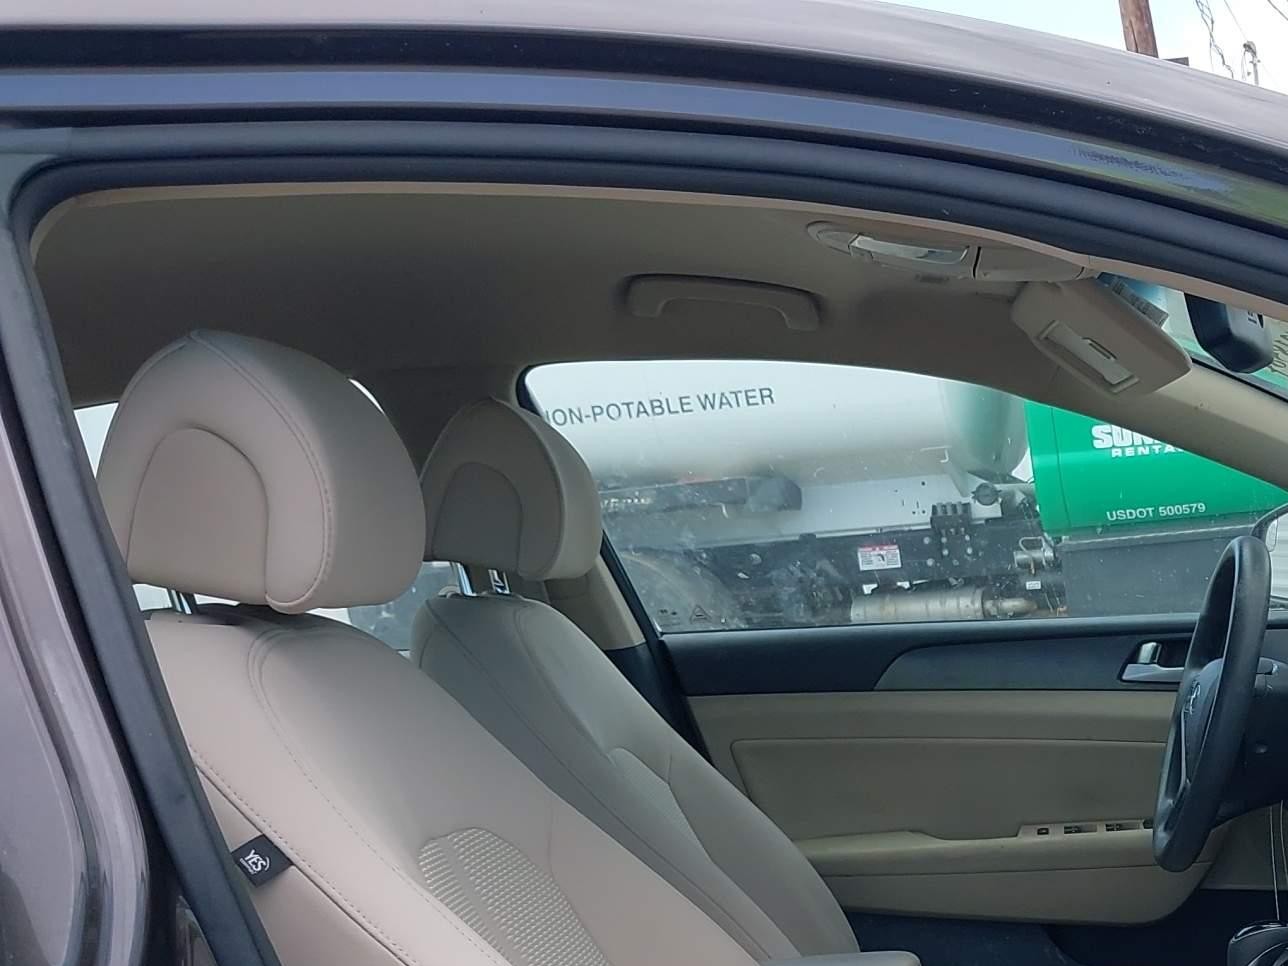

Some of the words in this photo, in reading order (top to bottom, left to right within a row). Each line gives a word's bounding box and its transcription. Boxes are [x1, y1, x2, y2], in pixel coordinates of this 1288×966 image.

[696, 387, 775, 412] WATER
[1106, 507, 1155, 521] USDOT
[1159, 502, 1206, 516] 500579
[244, 849, 267, 872] YES
